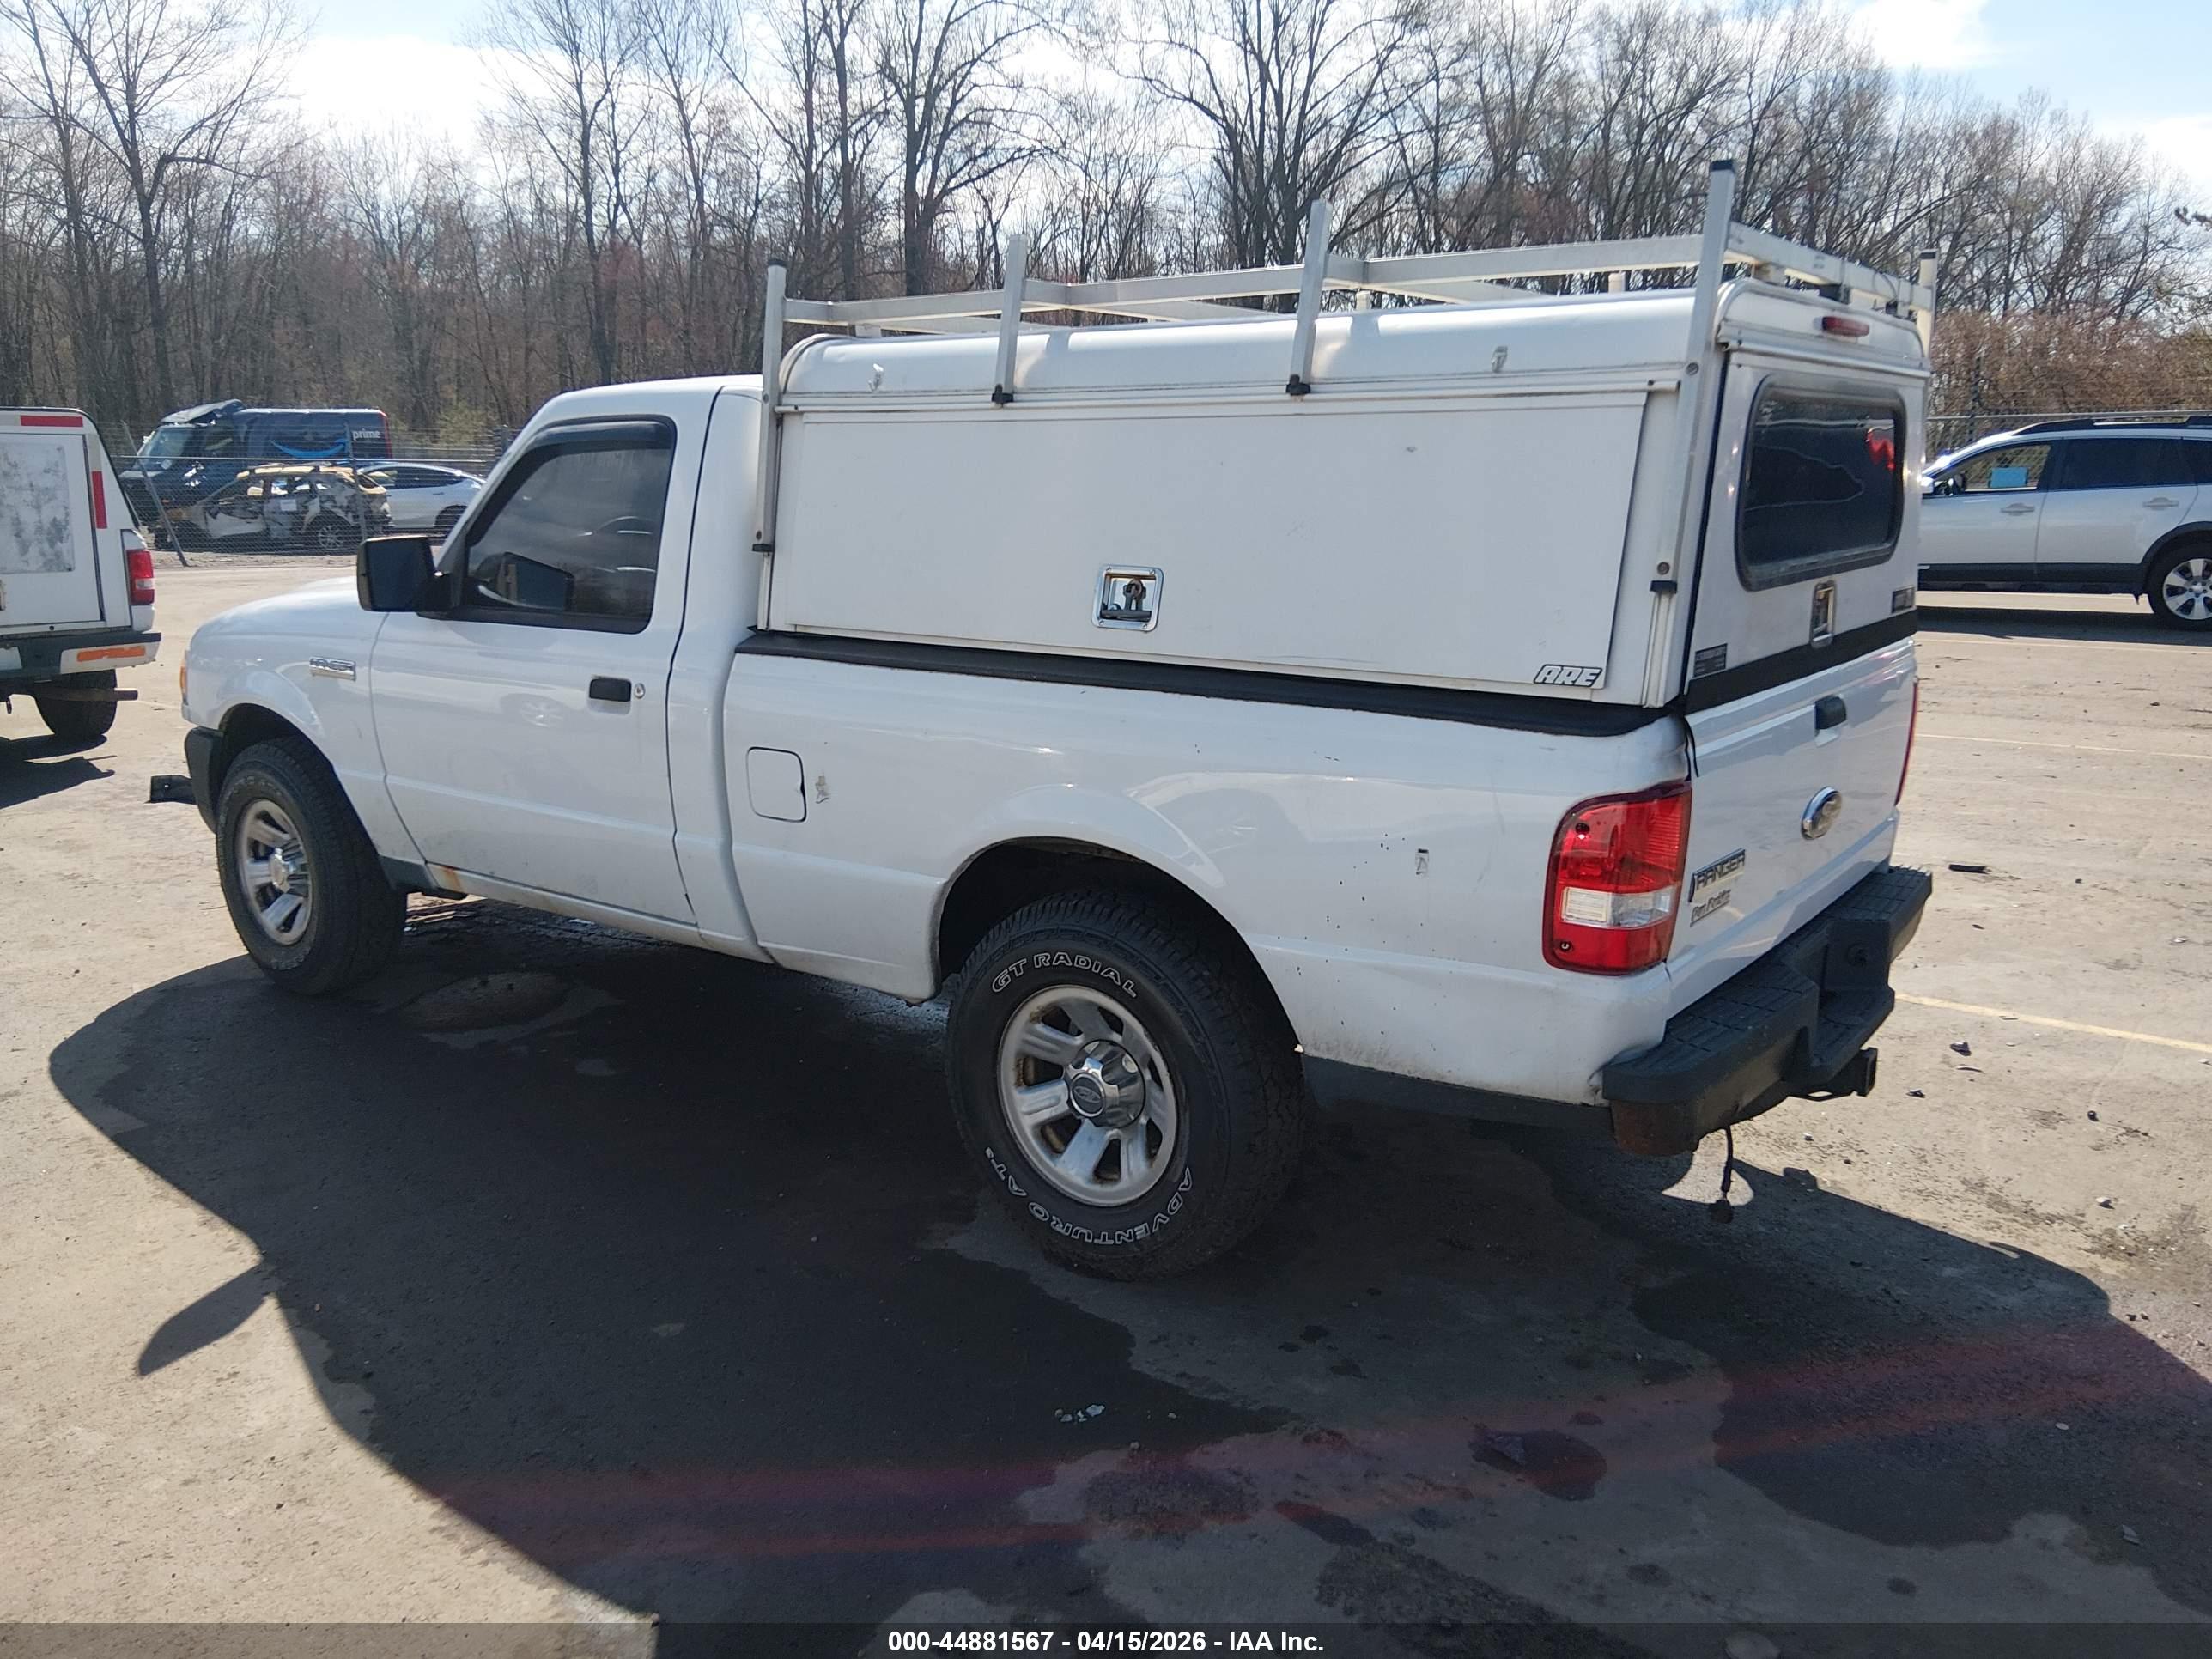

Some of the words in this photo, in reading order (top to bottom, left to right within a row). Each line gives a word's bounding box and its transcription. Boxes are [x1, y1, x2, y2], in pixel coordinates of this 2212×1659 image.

[352, 428, 380, 441] prime
[1533, 664, 1603, 687] ARE
[1696, 851, 1745, 890] RANGER
[992, 958, 1027, 992] GT
[1033, 951, 1137, 997] RADIAL
[1029, 1166, 1193, 1245] ADVENTURO
